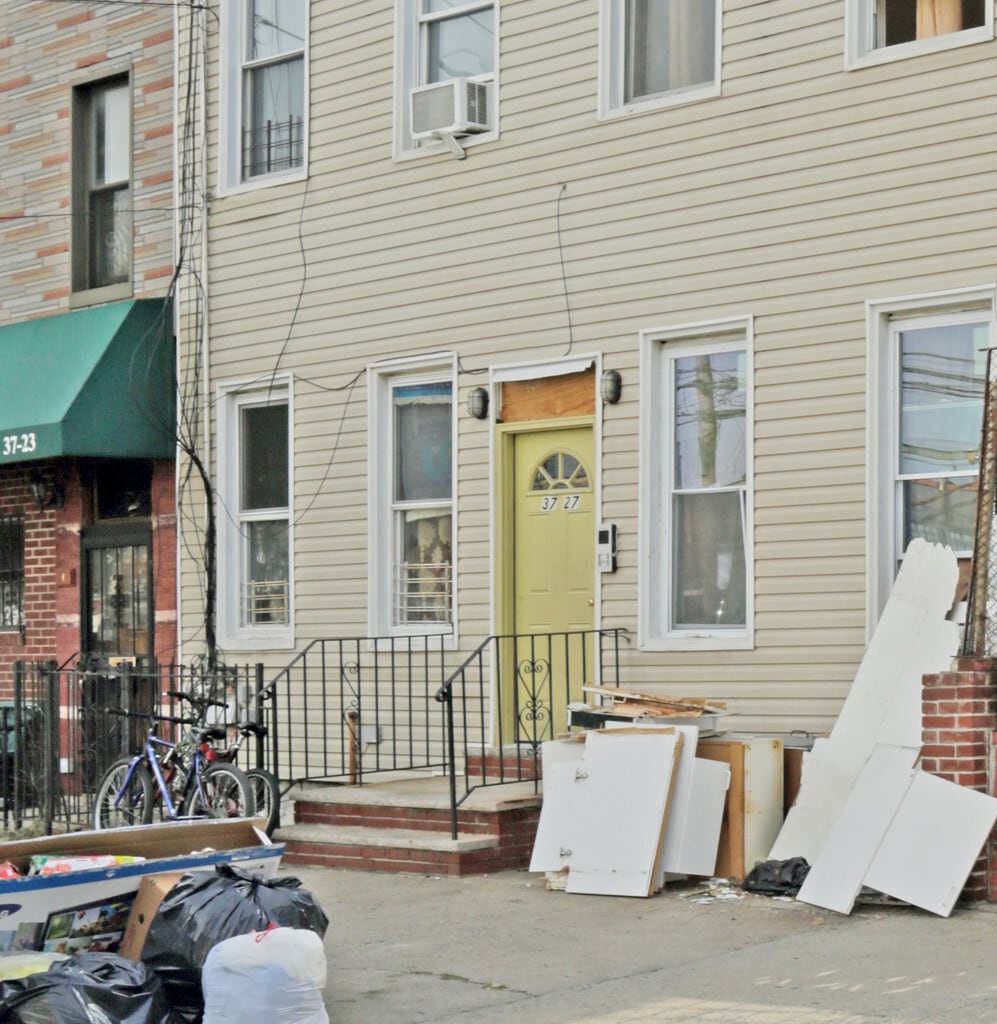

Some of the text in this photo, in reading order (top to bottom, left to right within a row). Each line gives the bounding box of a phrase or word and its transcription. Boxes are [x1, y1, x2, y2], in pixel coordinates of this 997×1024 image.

[3, 432, 36, 455] 37-23
[541, 495, 580, 511] 37 27
